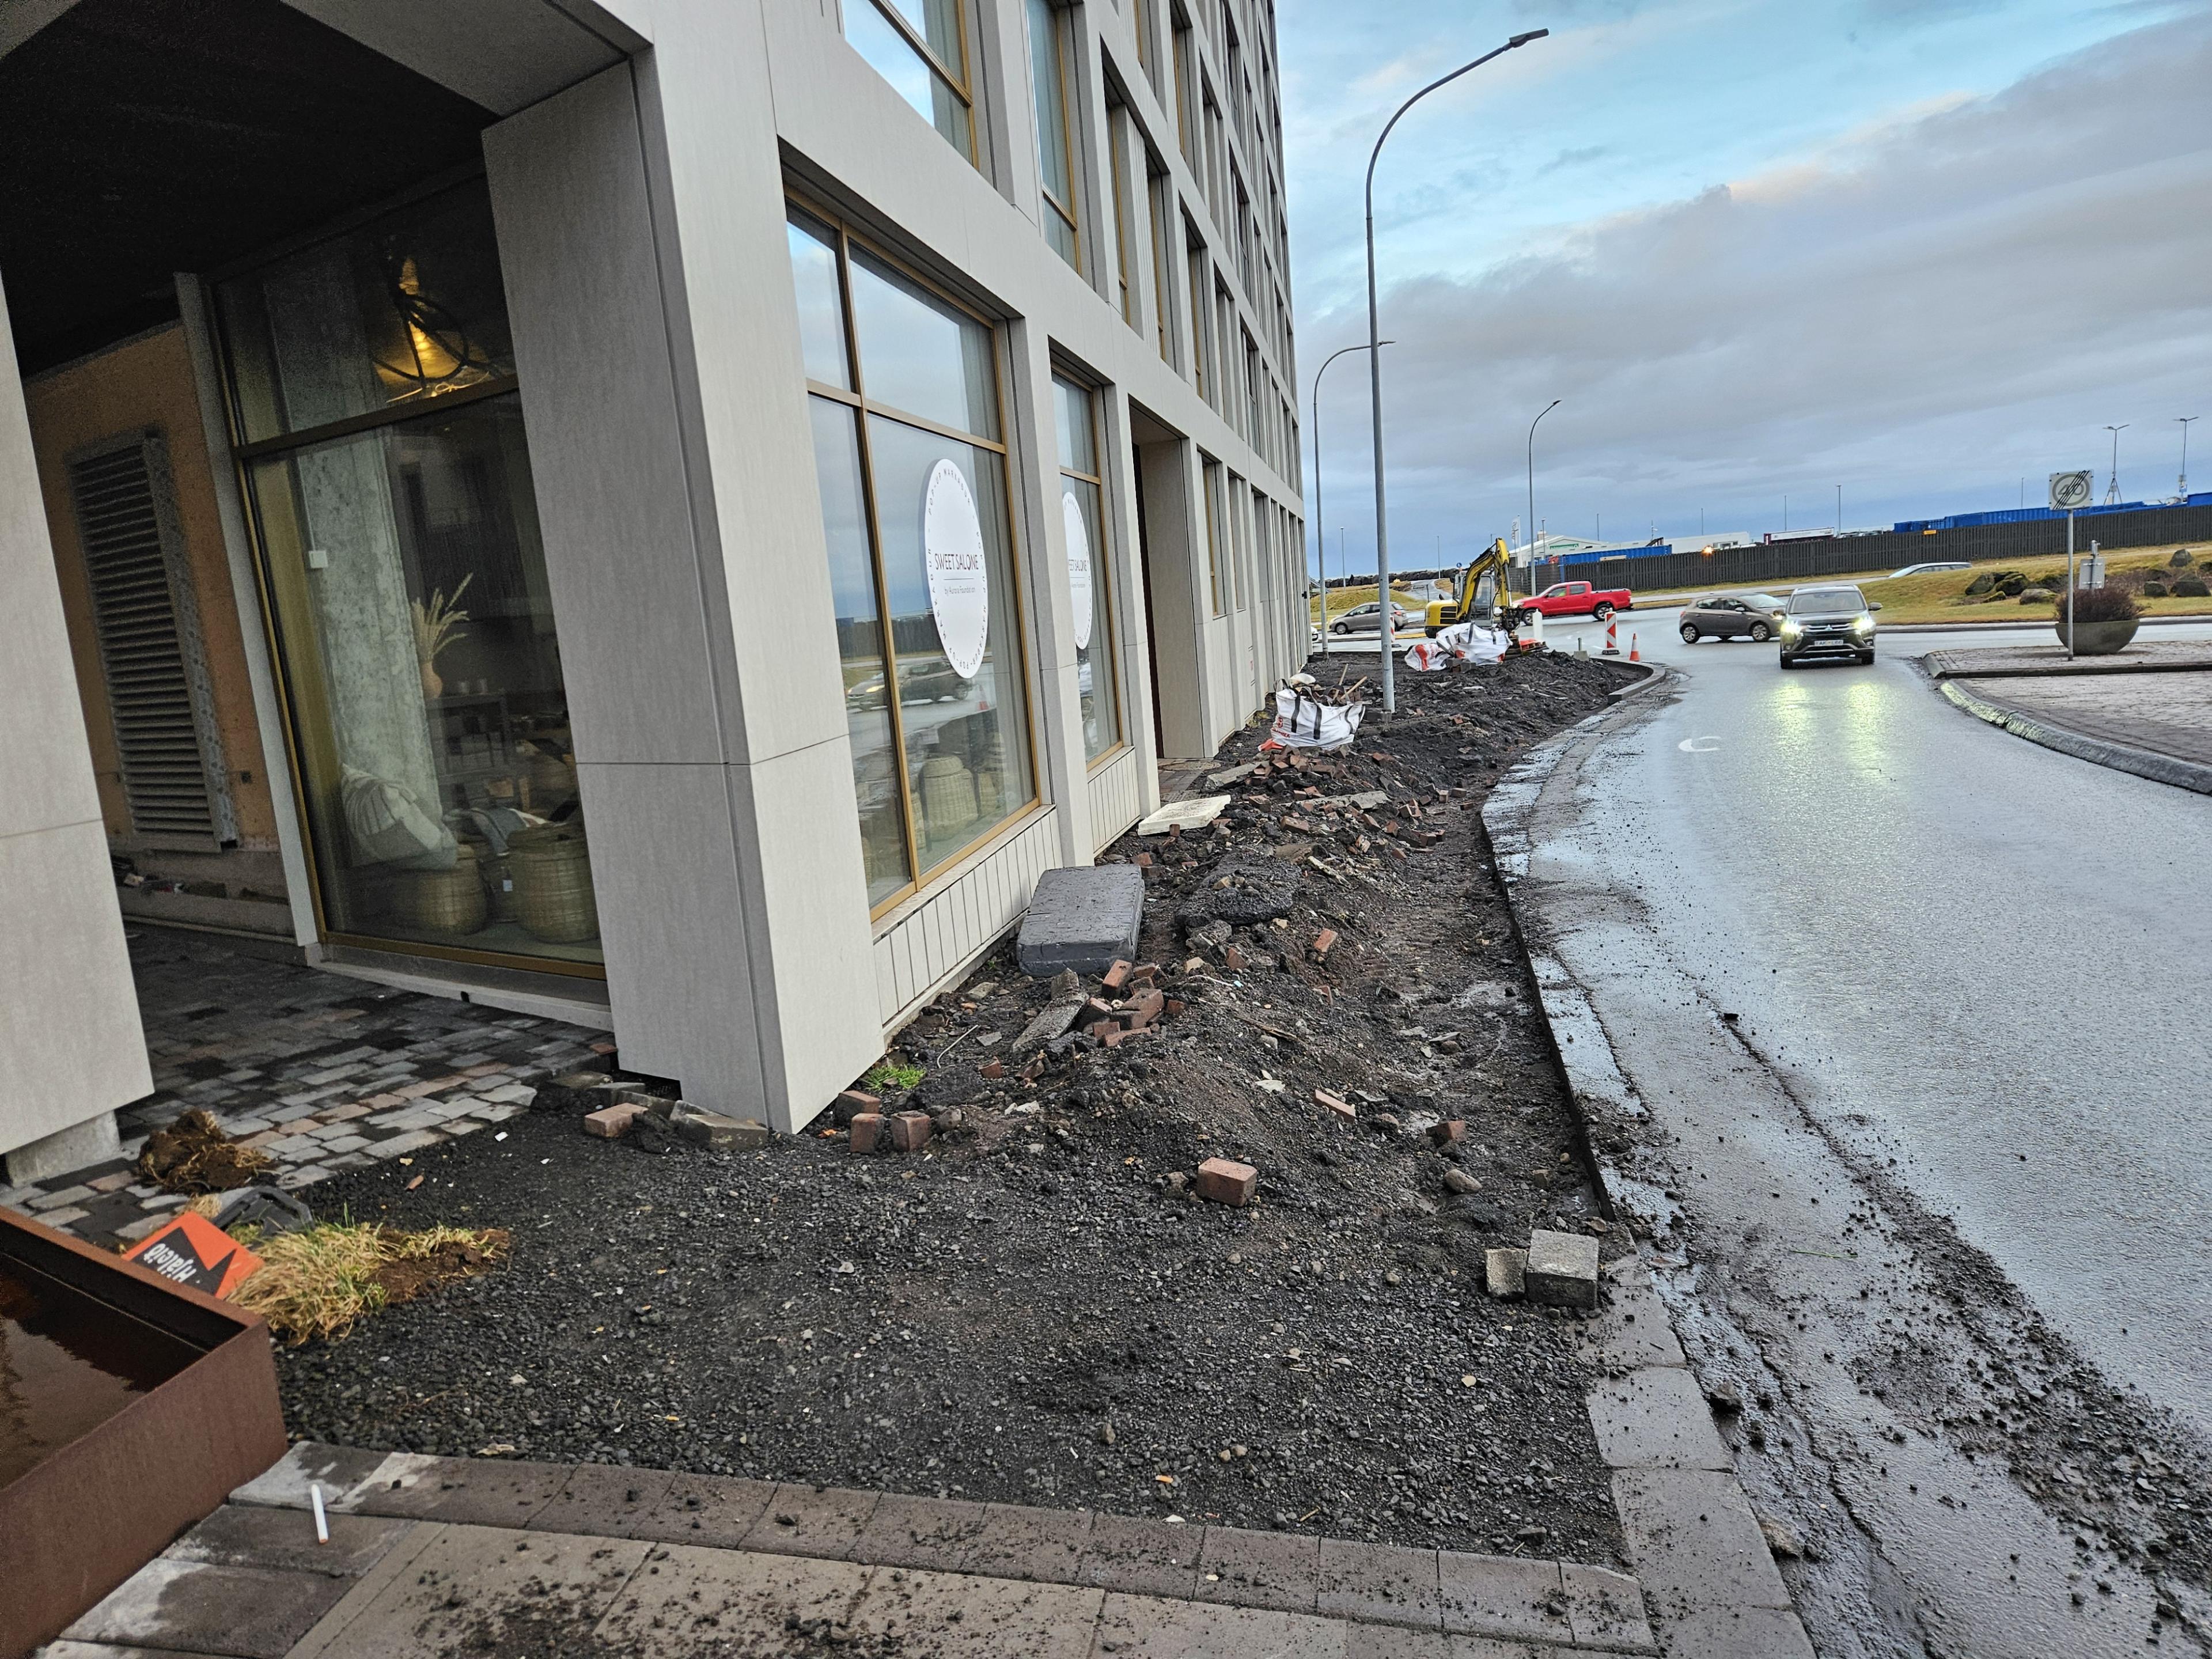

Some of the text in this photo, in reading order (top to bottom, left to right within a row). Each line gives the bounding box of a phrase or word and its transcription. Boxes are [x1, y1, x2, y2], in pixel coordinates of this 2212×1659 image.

[2058, 484, 2084, 495] 40
[934, 553, 979, 571] SWEET SALONE
